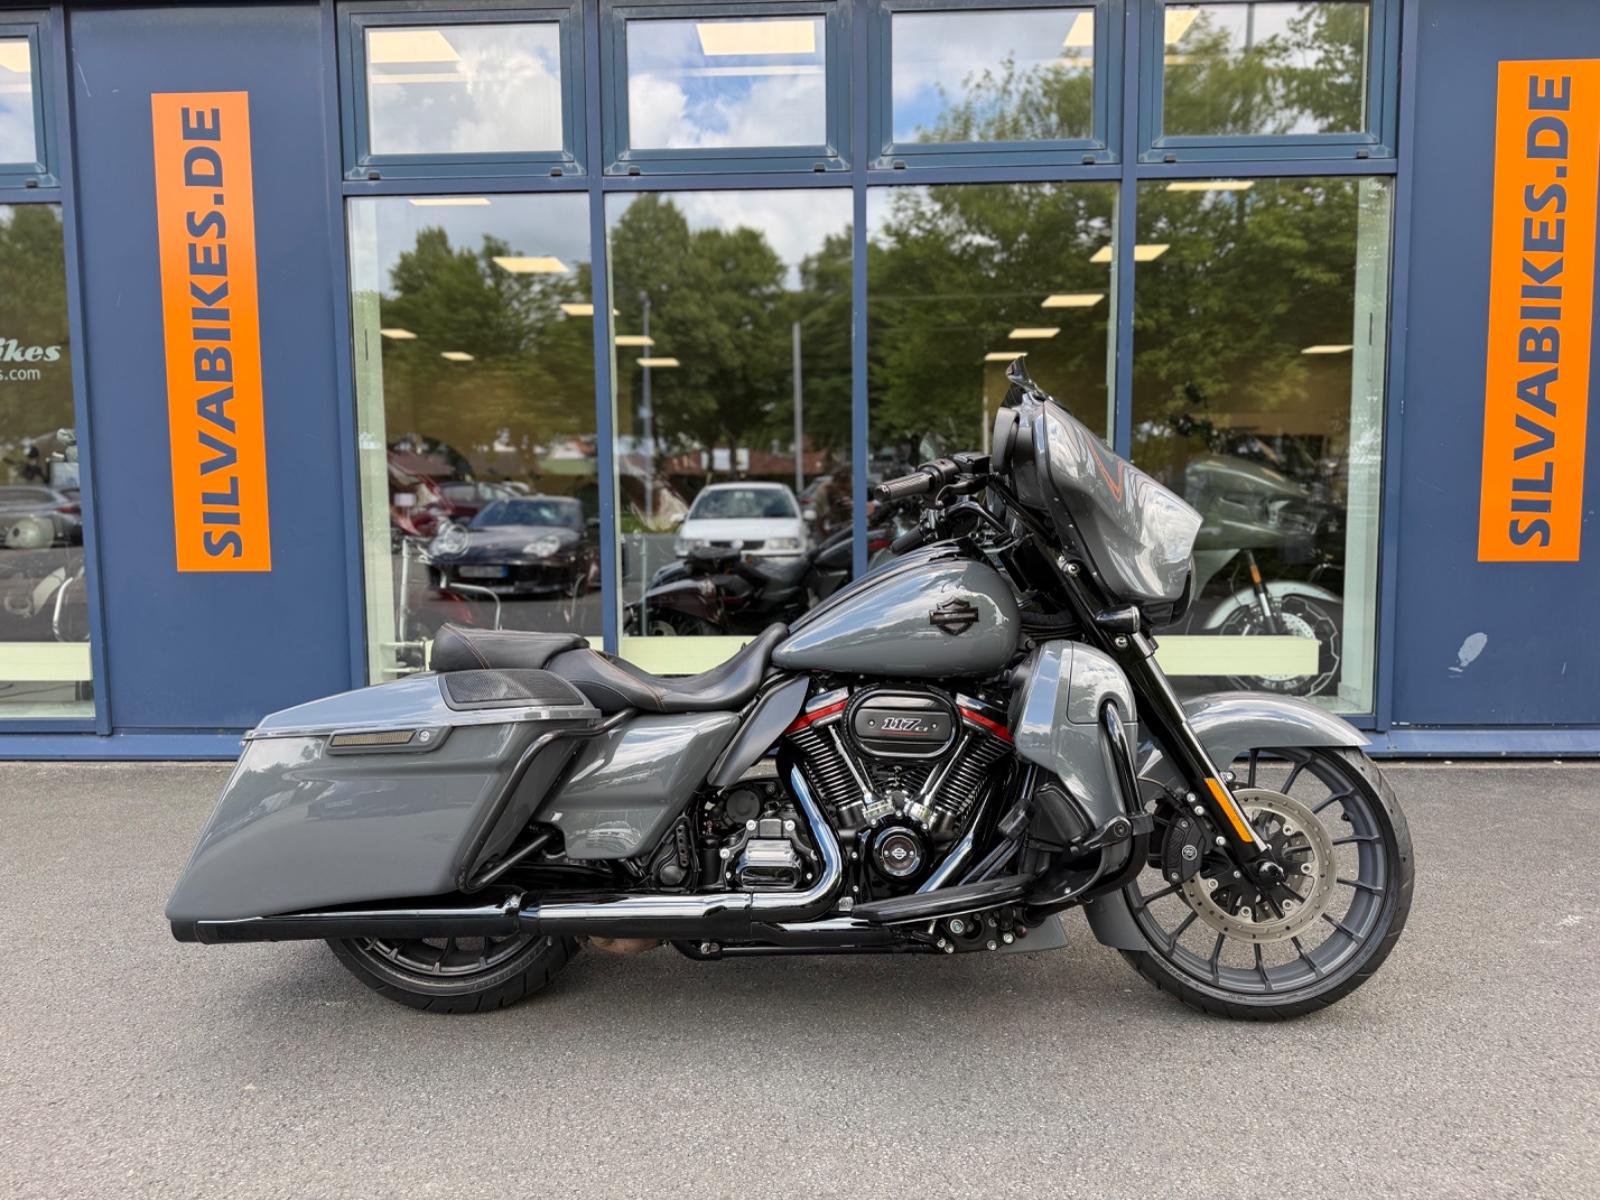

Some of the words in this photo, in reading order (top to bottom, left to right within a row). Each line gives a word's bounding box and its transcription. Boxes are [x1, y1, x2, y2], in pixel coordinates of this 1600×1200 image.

[181, 107, 243, 558] SILVABIKES.DE
[1509, 75, 1571, 547] SILVABIKES.DE
[881, 717, 922, 731] 117
